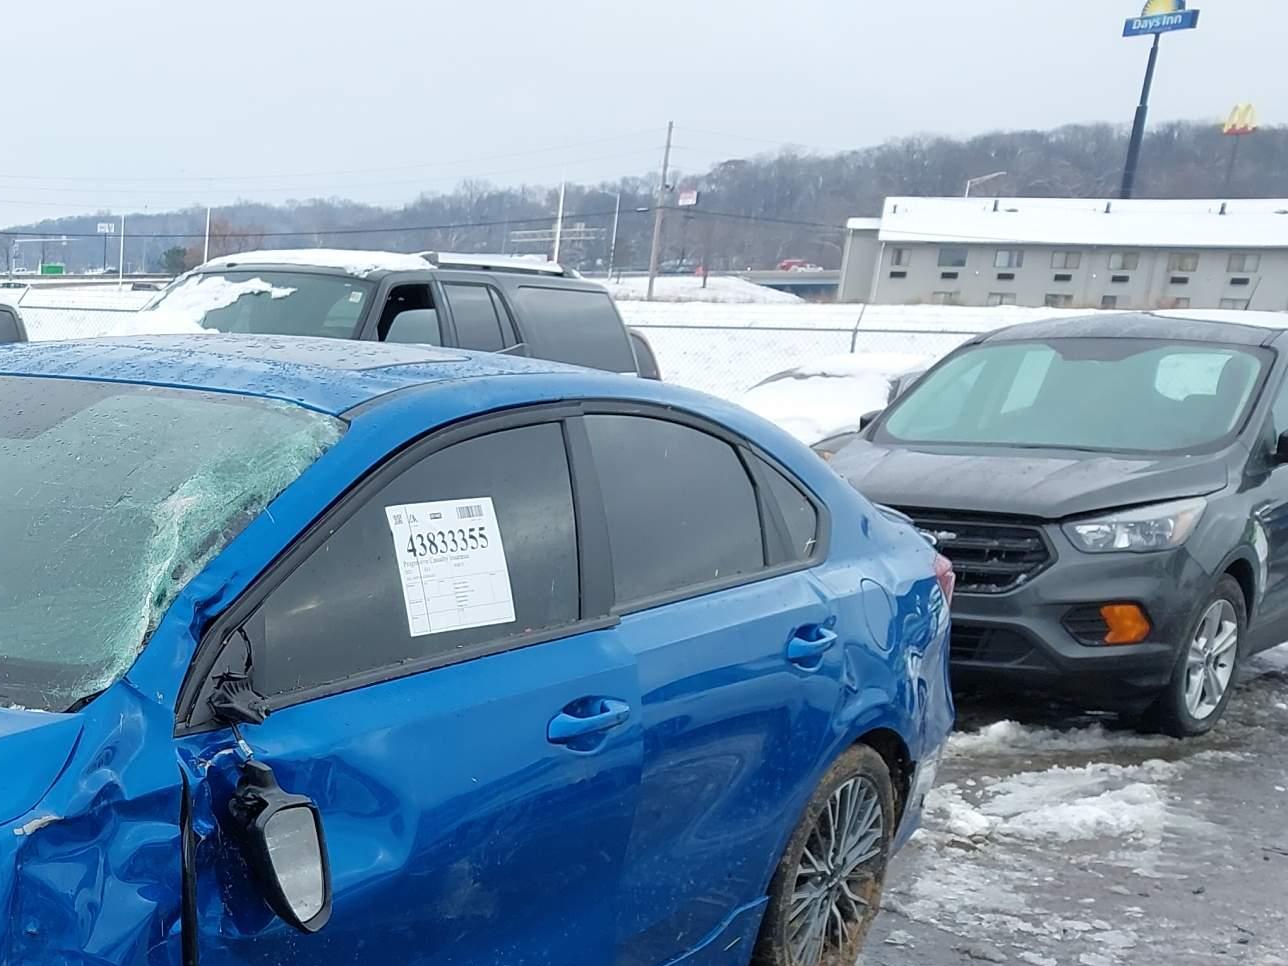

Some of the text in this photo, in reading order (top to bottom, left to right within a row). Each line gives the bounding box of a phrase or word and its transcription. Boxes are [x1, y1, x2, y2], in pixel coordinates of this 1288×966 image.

[1132, 17, 1161, 30] Days
[1162, 14, 1182, 25] Inn
[406, 526, 489, 557] 43833355
